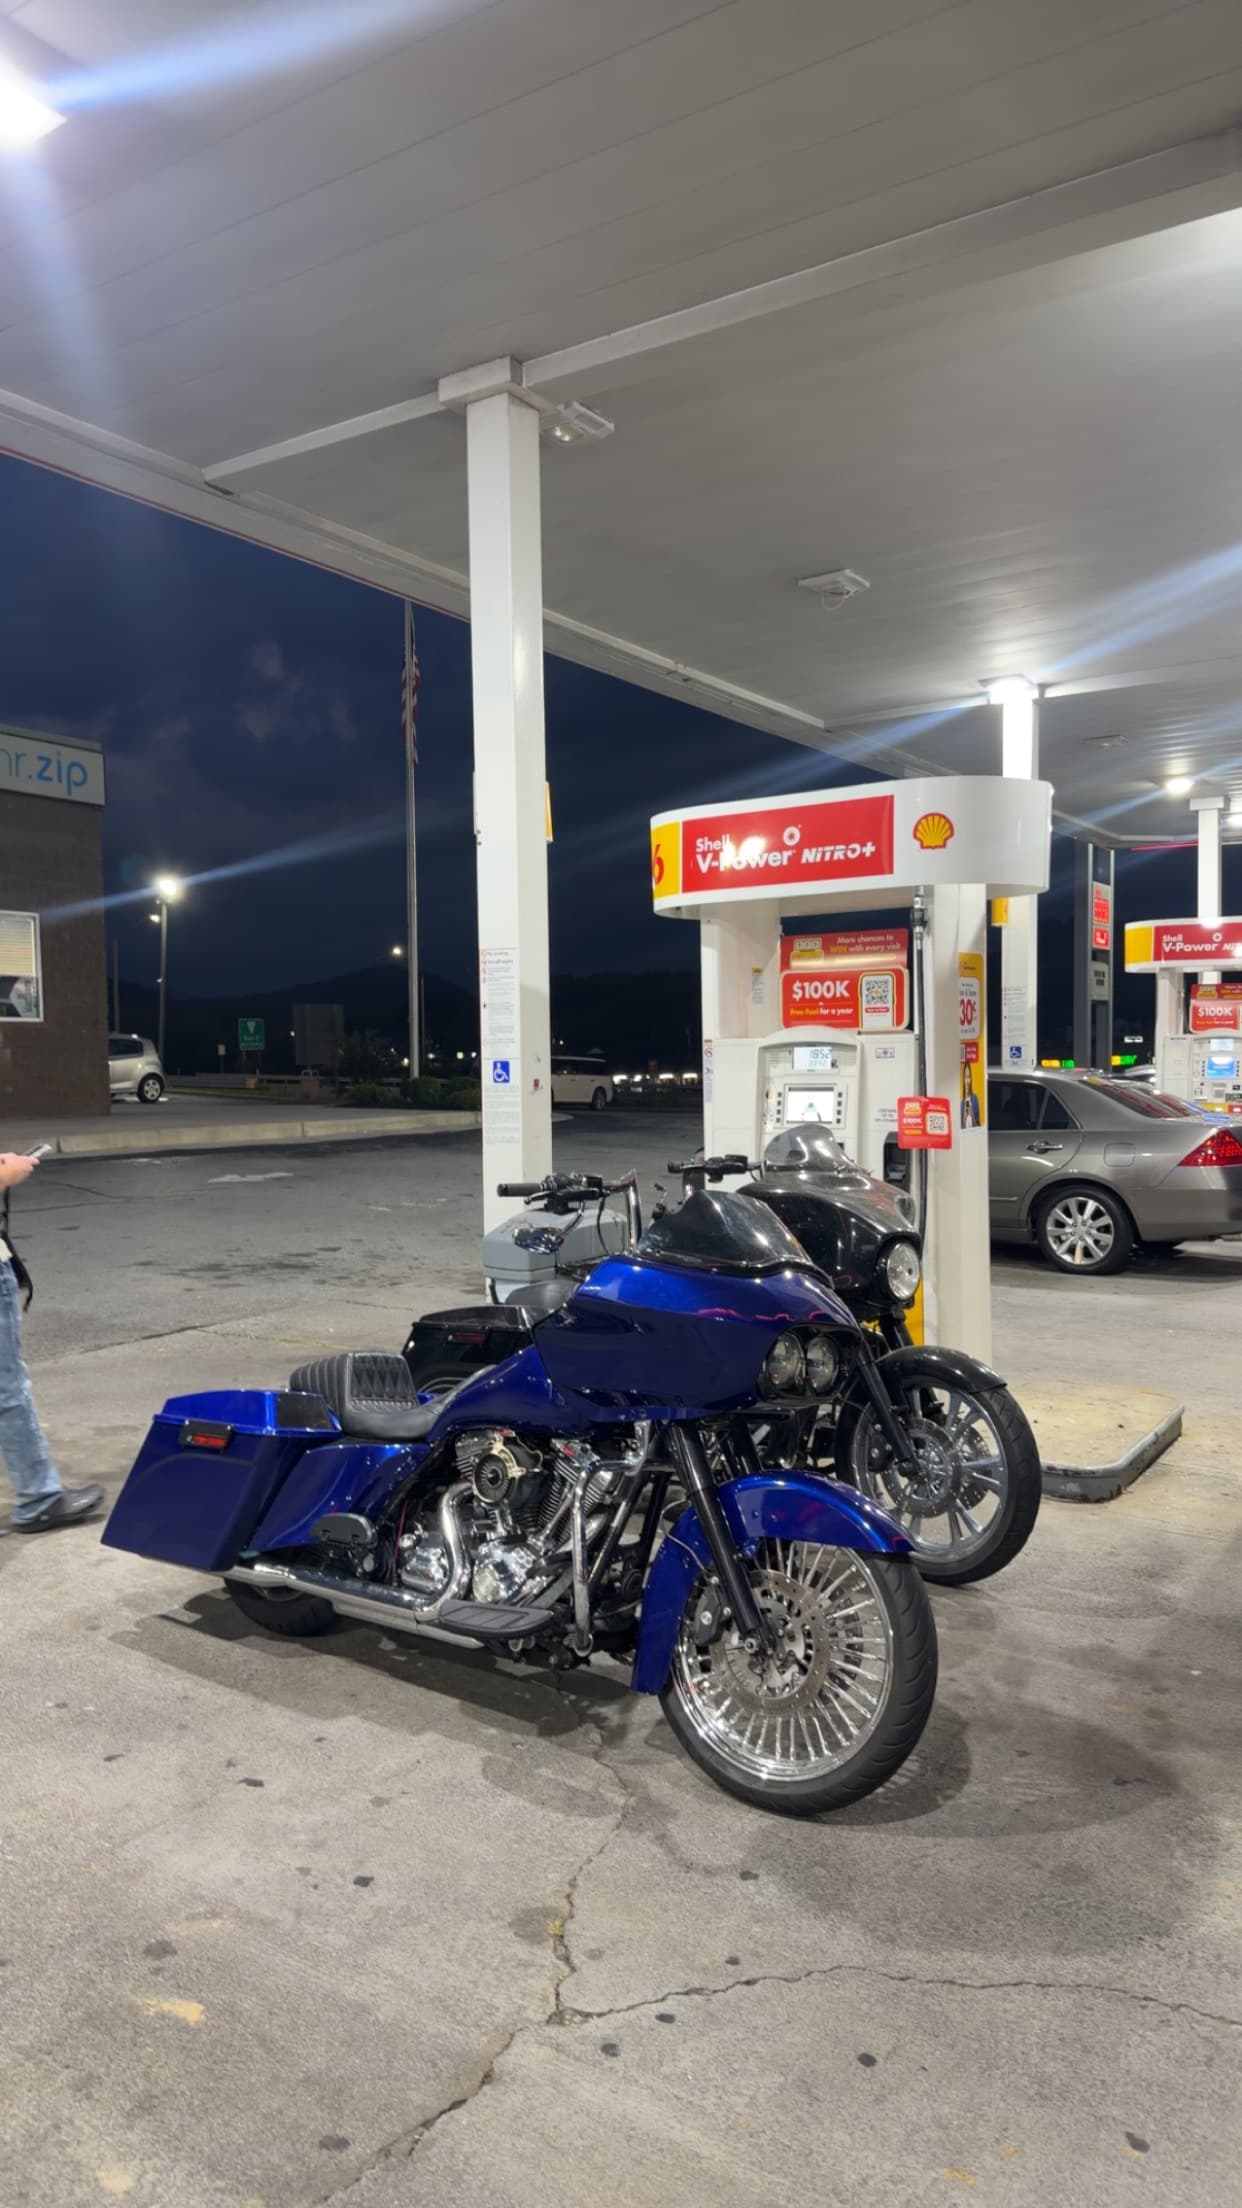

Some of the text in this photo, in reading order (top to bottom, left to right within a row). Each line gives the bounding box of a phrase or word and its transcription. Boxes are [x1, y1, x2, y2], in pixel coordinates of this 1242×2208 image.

[696, 834, 731, 853] Shell
[652, 844, 665, 886] 6
[1162, 934, 1183, 943] Shell
[1162, 942, 1218, 952] V-Power
[792, 980, 851, 1002] $100K
